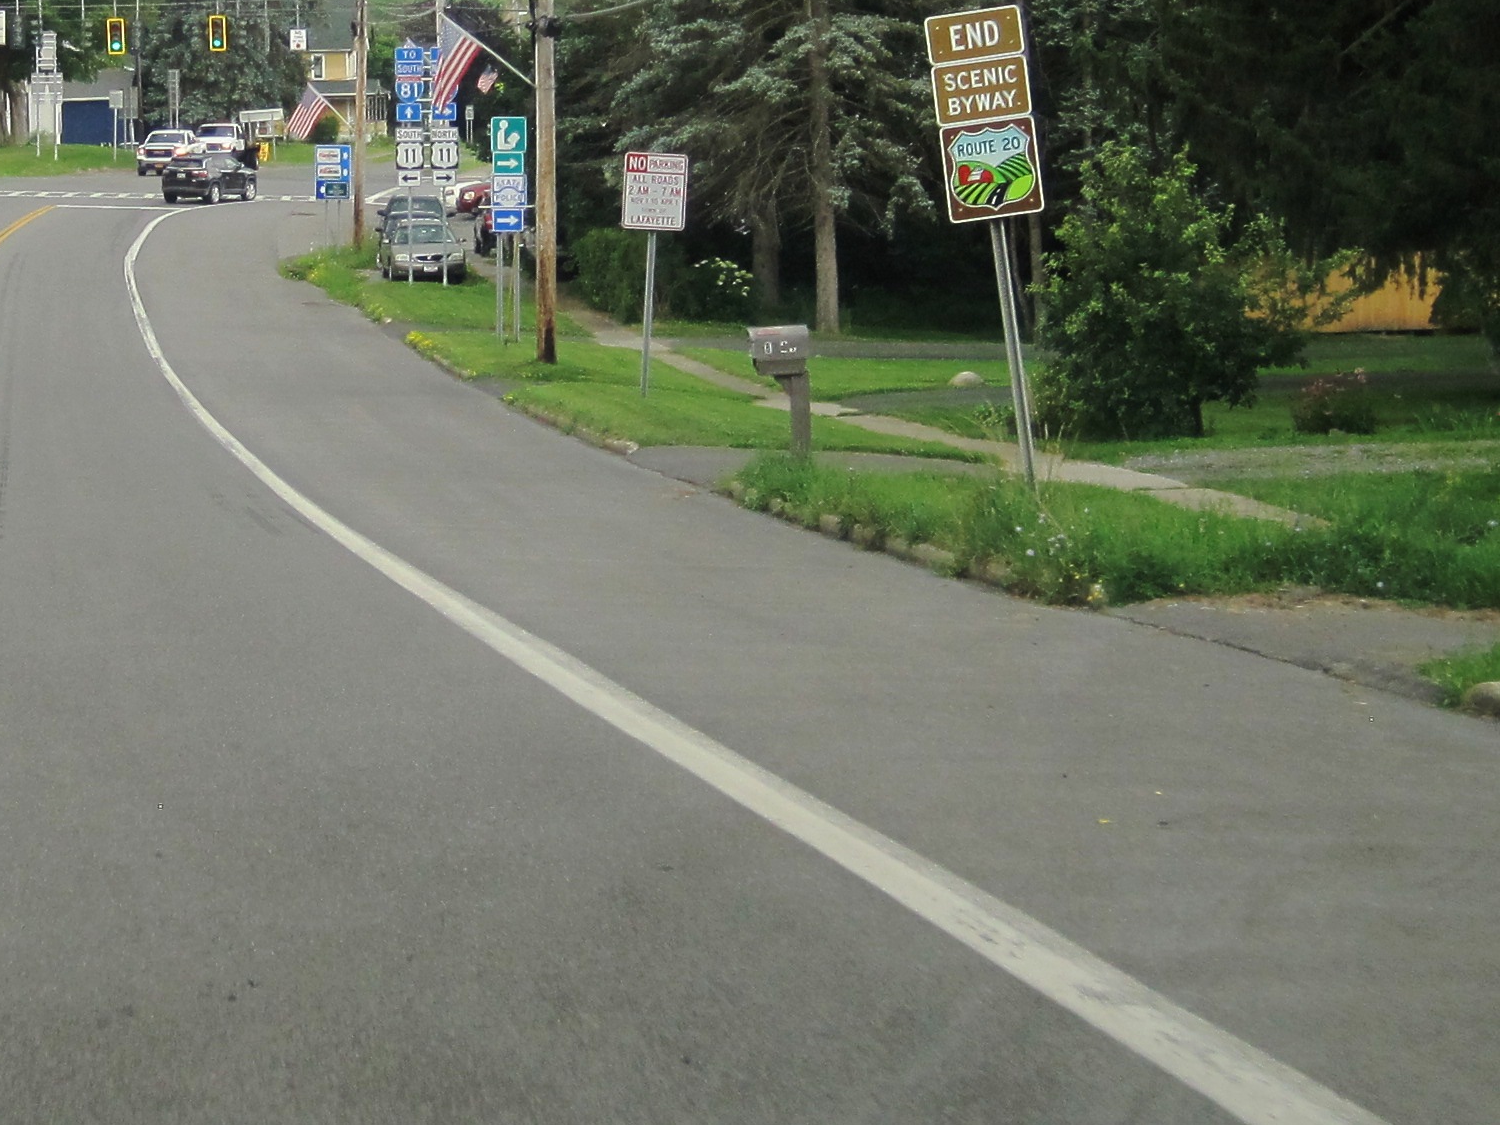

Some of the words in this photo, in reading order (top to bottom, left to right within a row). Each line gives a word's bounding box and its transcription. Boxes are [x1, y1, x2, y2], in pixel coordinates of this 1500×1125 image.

[949, 20, 1000, 52] END
[402, 50, 416, 59] TO
[397, 64, 421, 73] SOUTH
[944, 65, 1017, 91] SCENIC
[401, 82, 418, 98] 81
[947, 89, 1016, 116] BYWAY
[397, 129, 421, 139] SOUTH
[432, 130, 457, 139] NORTH
[957, 139, 997, 157] ROUTE
[1002, 136, 1021, 151] 20
[404, 148, 416, 163] 11
[439, 147, 451, 163] 11
[629, 156, 647, 170] NO
[650, 159, 684, 170] PARKING
[496, 179, 524, 189] STATE
[632, 175, 647, 184] ALL
[651, 175, 679, 185] ROADS
[628, 185, 634, 195] 2
[637, 185, 649, 196] AM
[662, 187, 667, 196] 7
[670, 187, 682, 197] AM
[496, 194, 524, 202] POLICE
[630, 215, 676, 226] LAFAYETTE
